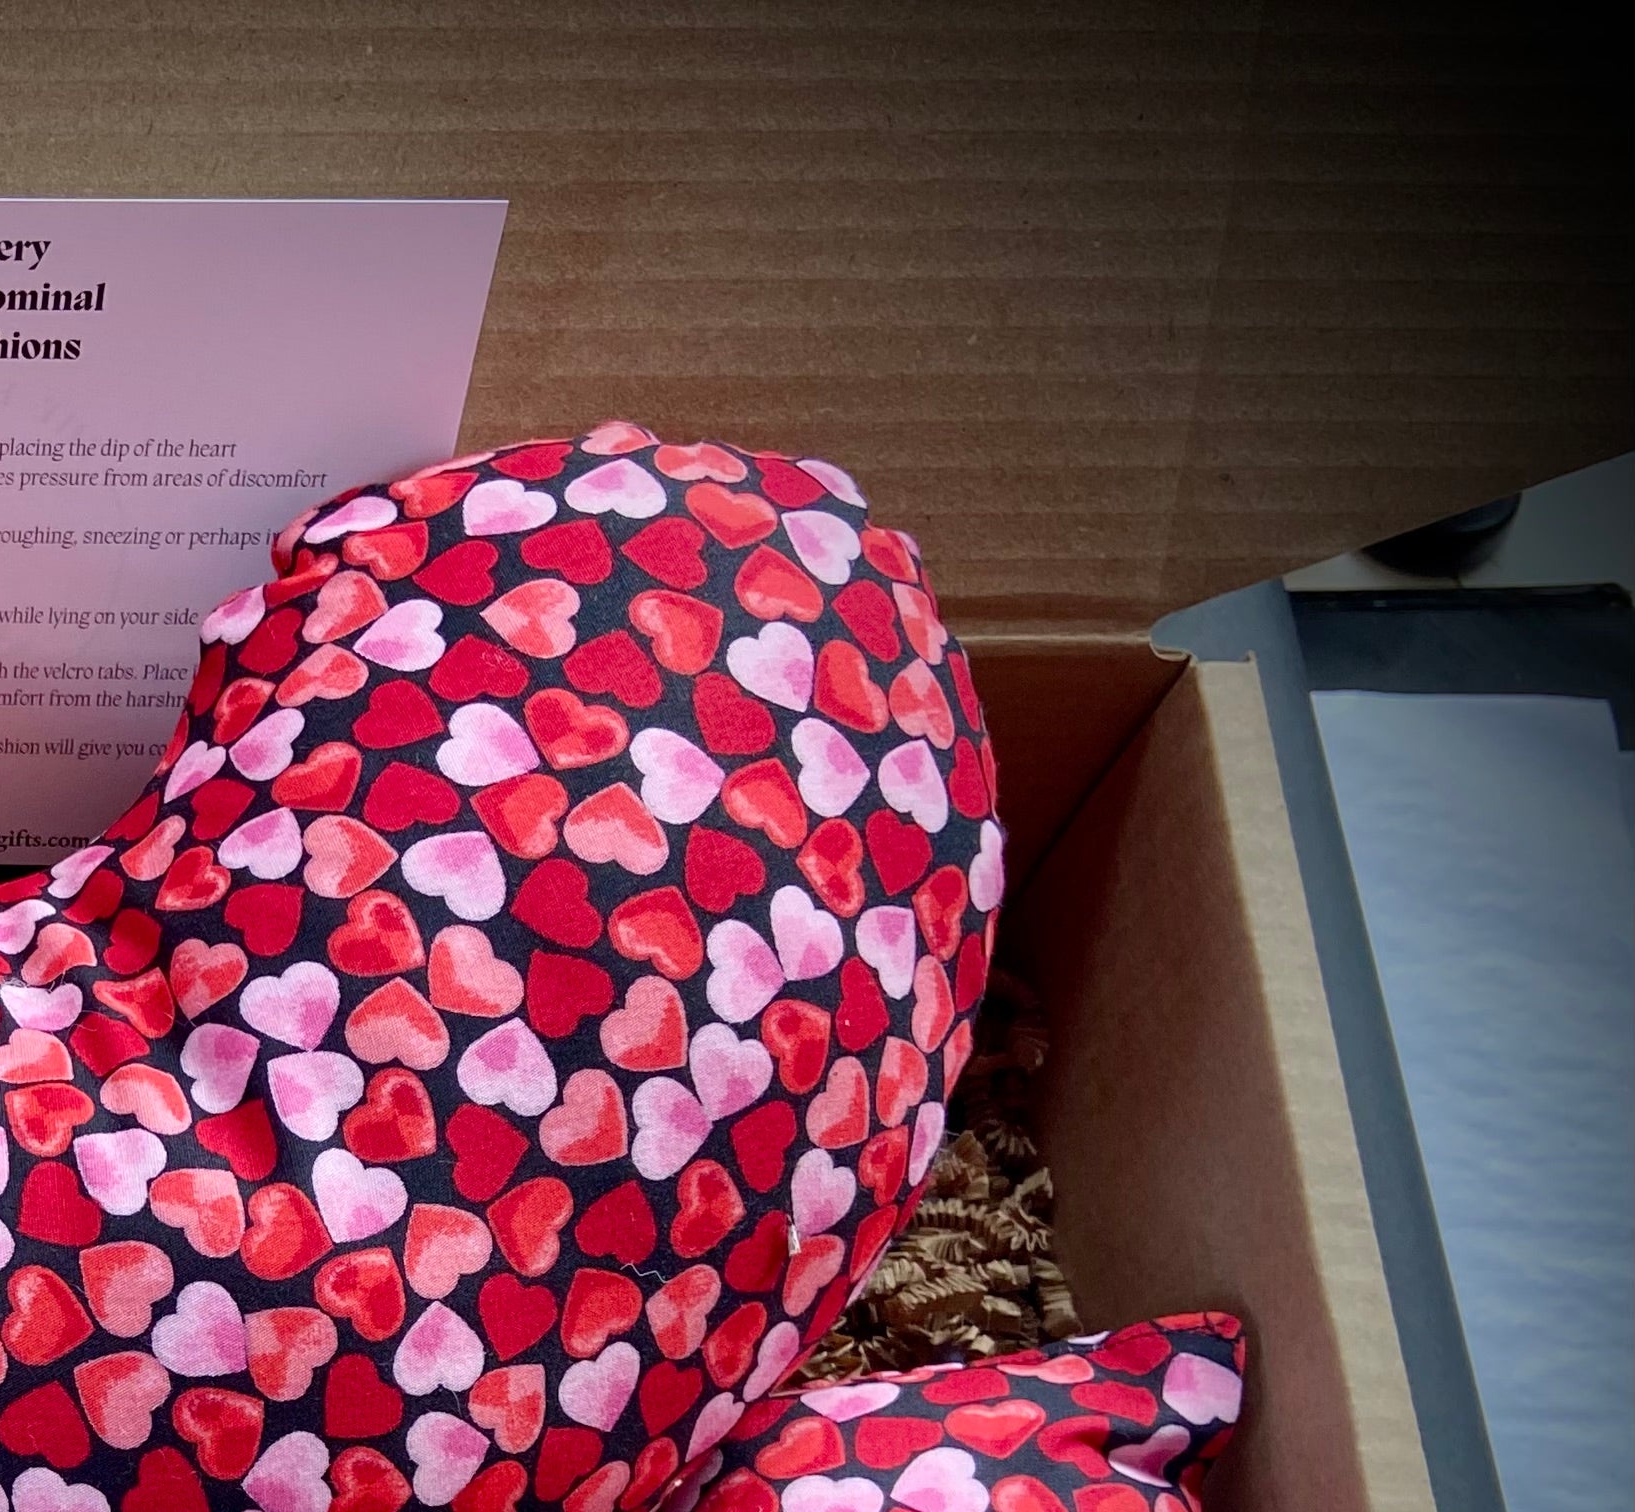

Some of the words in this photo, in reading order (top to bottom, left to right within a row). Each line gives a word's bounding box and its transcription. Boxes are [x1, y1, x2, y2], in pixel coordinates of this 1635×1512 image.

[69, 438, 97, 457] the
[100, 438, 130, 463] dip
[133, 438, 154, 457] of
[157, 439, 184, 457] the
[188, 439, 237, 458] heart
[19, 472, 99, 491] pressure
[103, 467, 148, 487] from
[152, 472, 203, 487] areas
[207, 469, 227, 487] of
[229, 469, 328, 487] discomfort
[82, 527, 163, 550] sneezing
[164, 531, 186, 545] or
[188, 527, 261, 550] perhaps
[48, 607, 92, 630] lying
[93, 611, 115, 625] on
[120, 611, 160, 629] your
[163, 607, 199, 626] side
[13, 661, 40, 680] the
[43, 662, 94, 680] velcro
[98, 662, 137, 680] tabs.
[142, 663, 188, 681] Place
[49, 689, 91, 707] from
[96, 690, 123, 707] the
[44, 738, 74, 755] will
[77, 739, 112, 761] give
[116, 743, 145, 760] you
